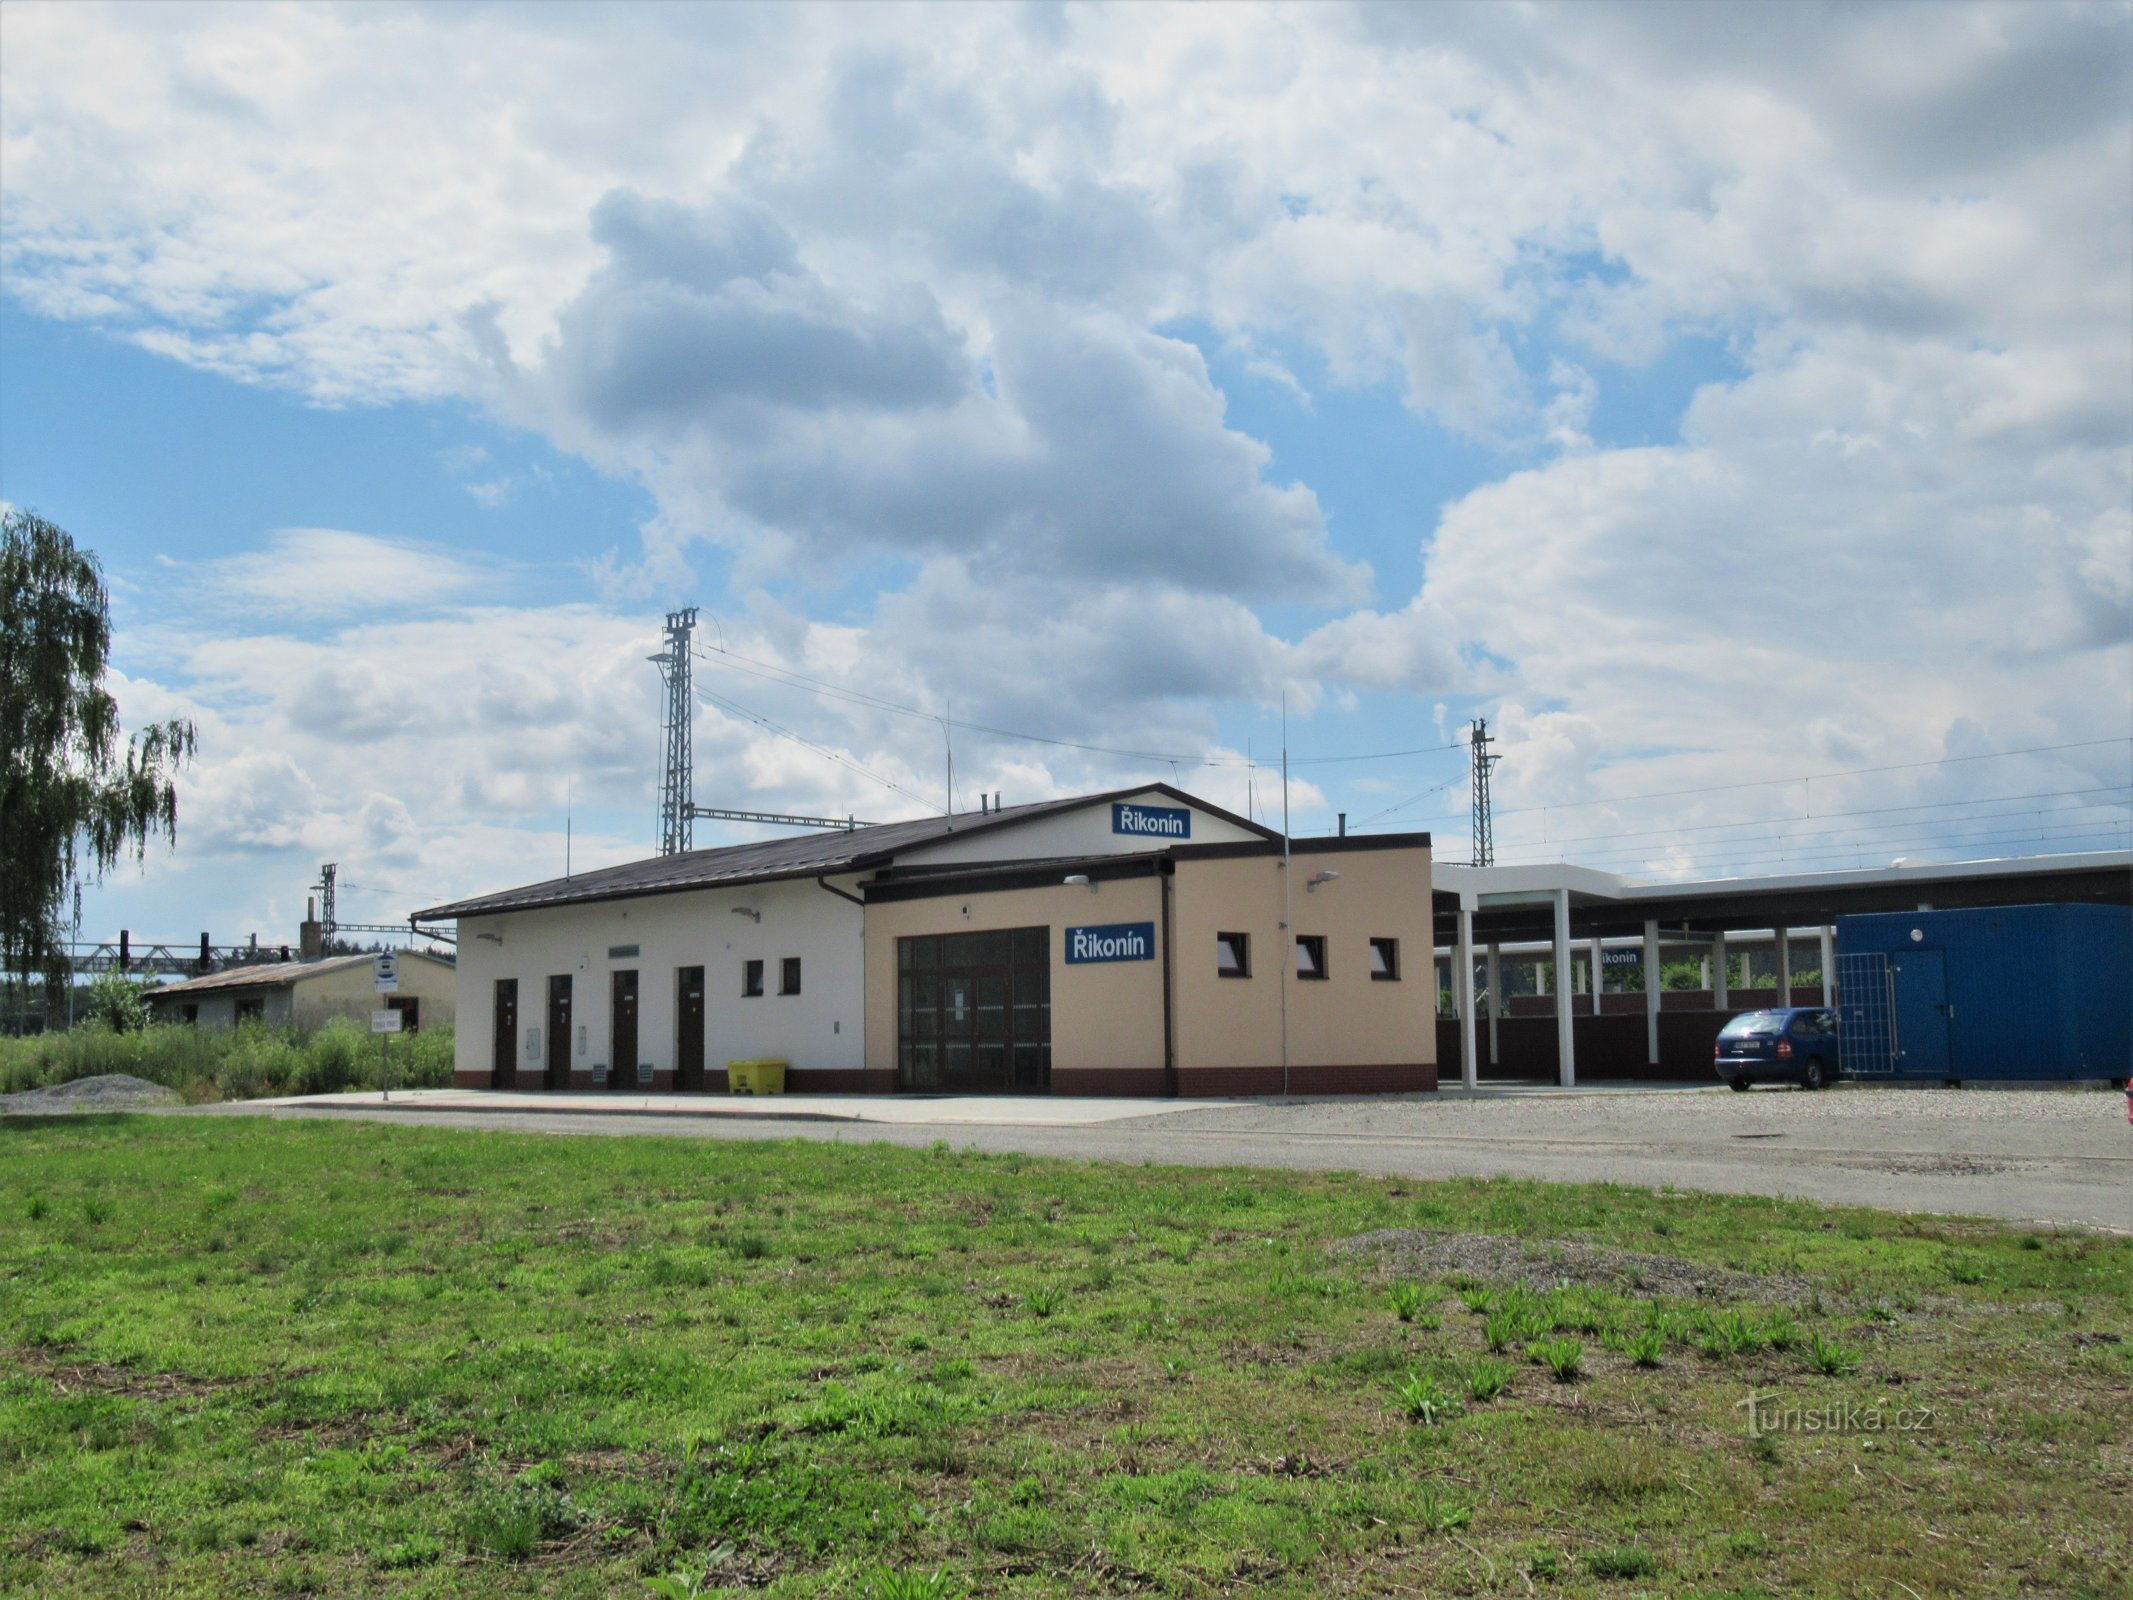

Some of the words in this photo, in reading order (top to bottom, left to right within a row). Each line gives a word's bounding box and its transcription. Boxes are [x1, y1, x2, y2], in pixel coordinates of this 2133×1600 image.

[1121, 806, 1183, 834] Řikonín
[1074, 929, 1145, 959] Řikonín
[1602, 951, 1637, 964] ikonín
